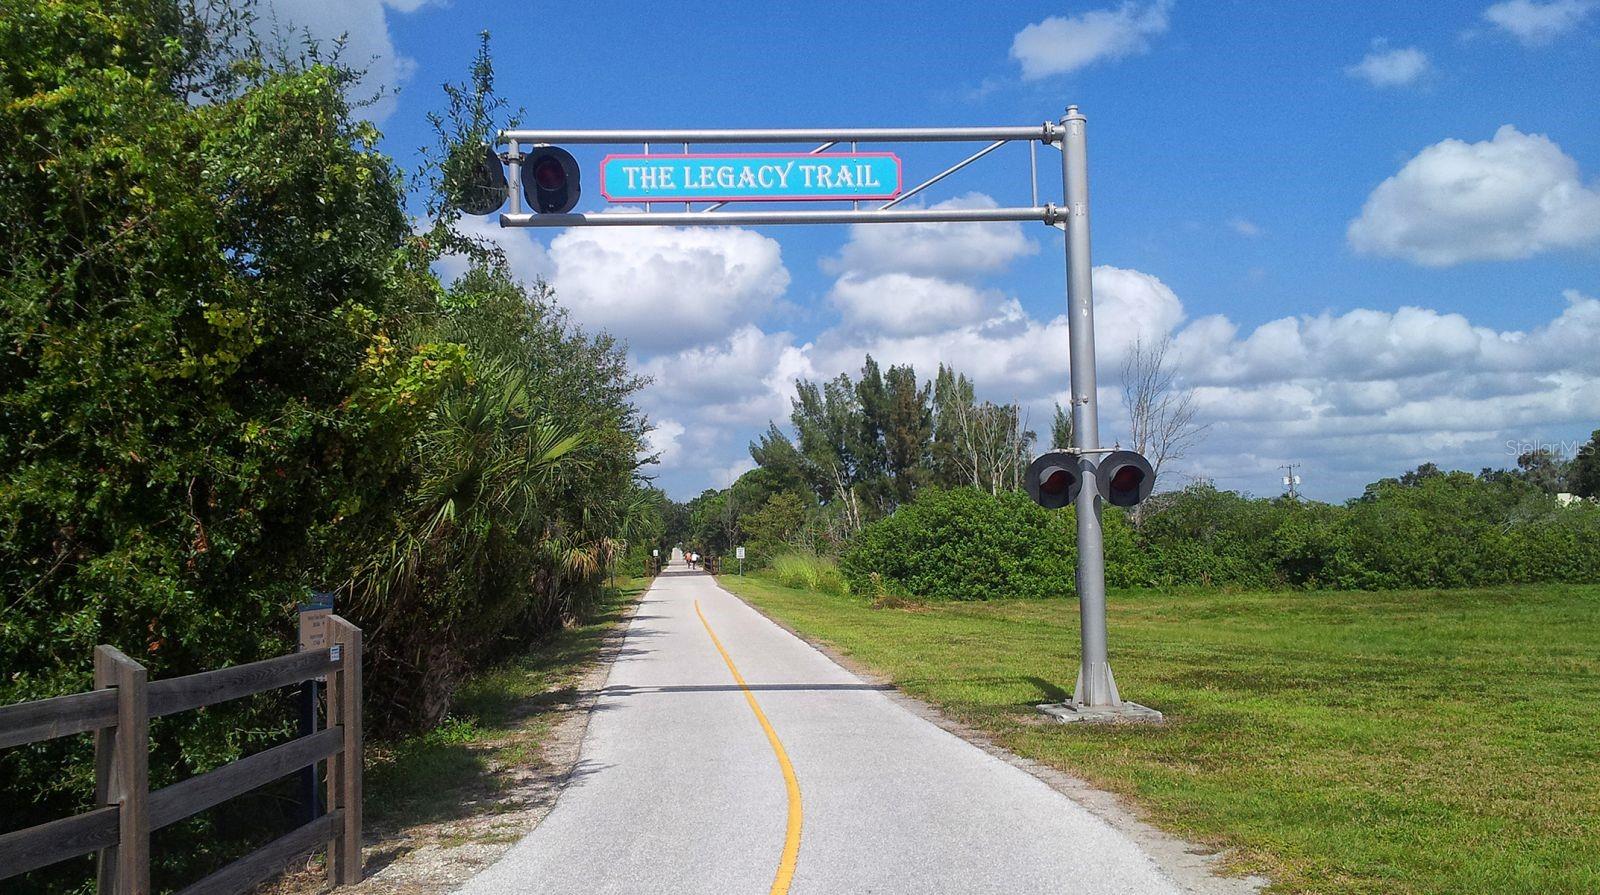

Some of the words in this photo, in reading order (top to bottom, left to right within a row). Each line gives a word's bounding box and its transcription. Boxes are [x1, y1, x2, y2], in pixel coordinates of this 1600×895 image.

[622, 165, 676, 189] THE
[684, 161, 795, 189] LEGACY
[799, 163, 880, 188] TRAIL
